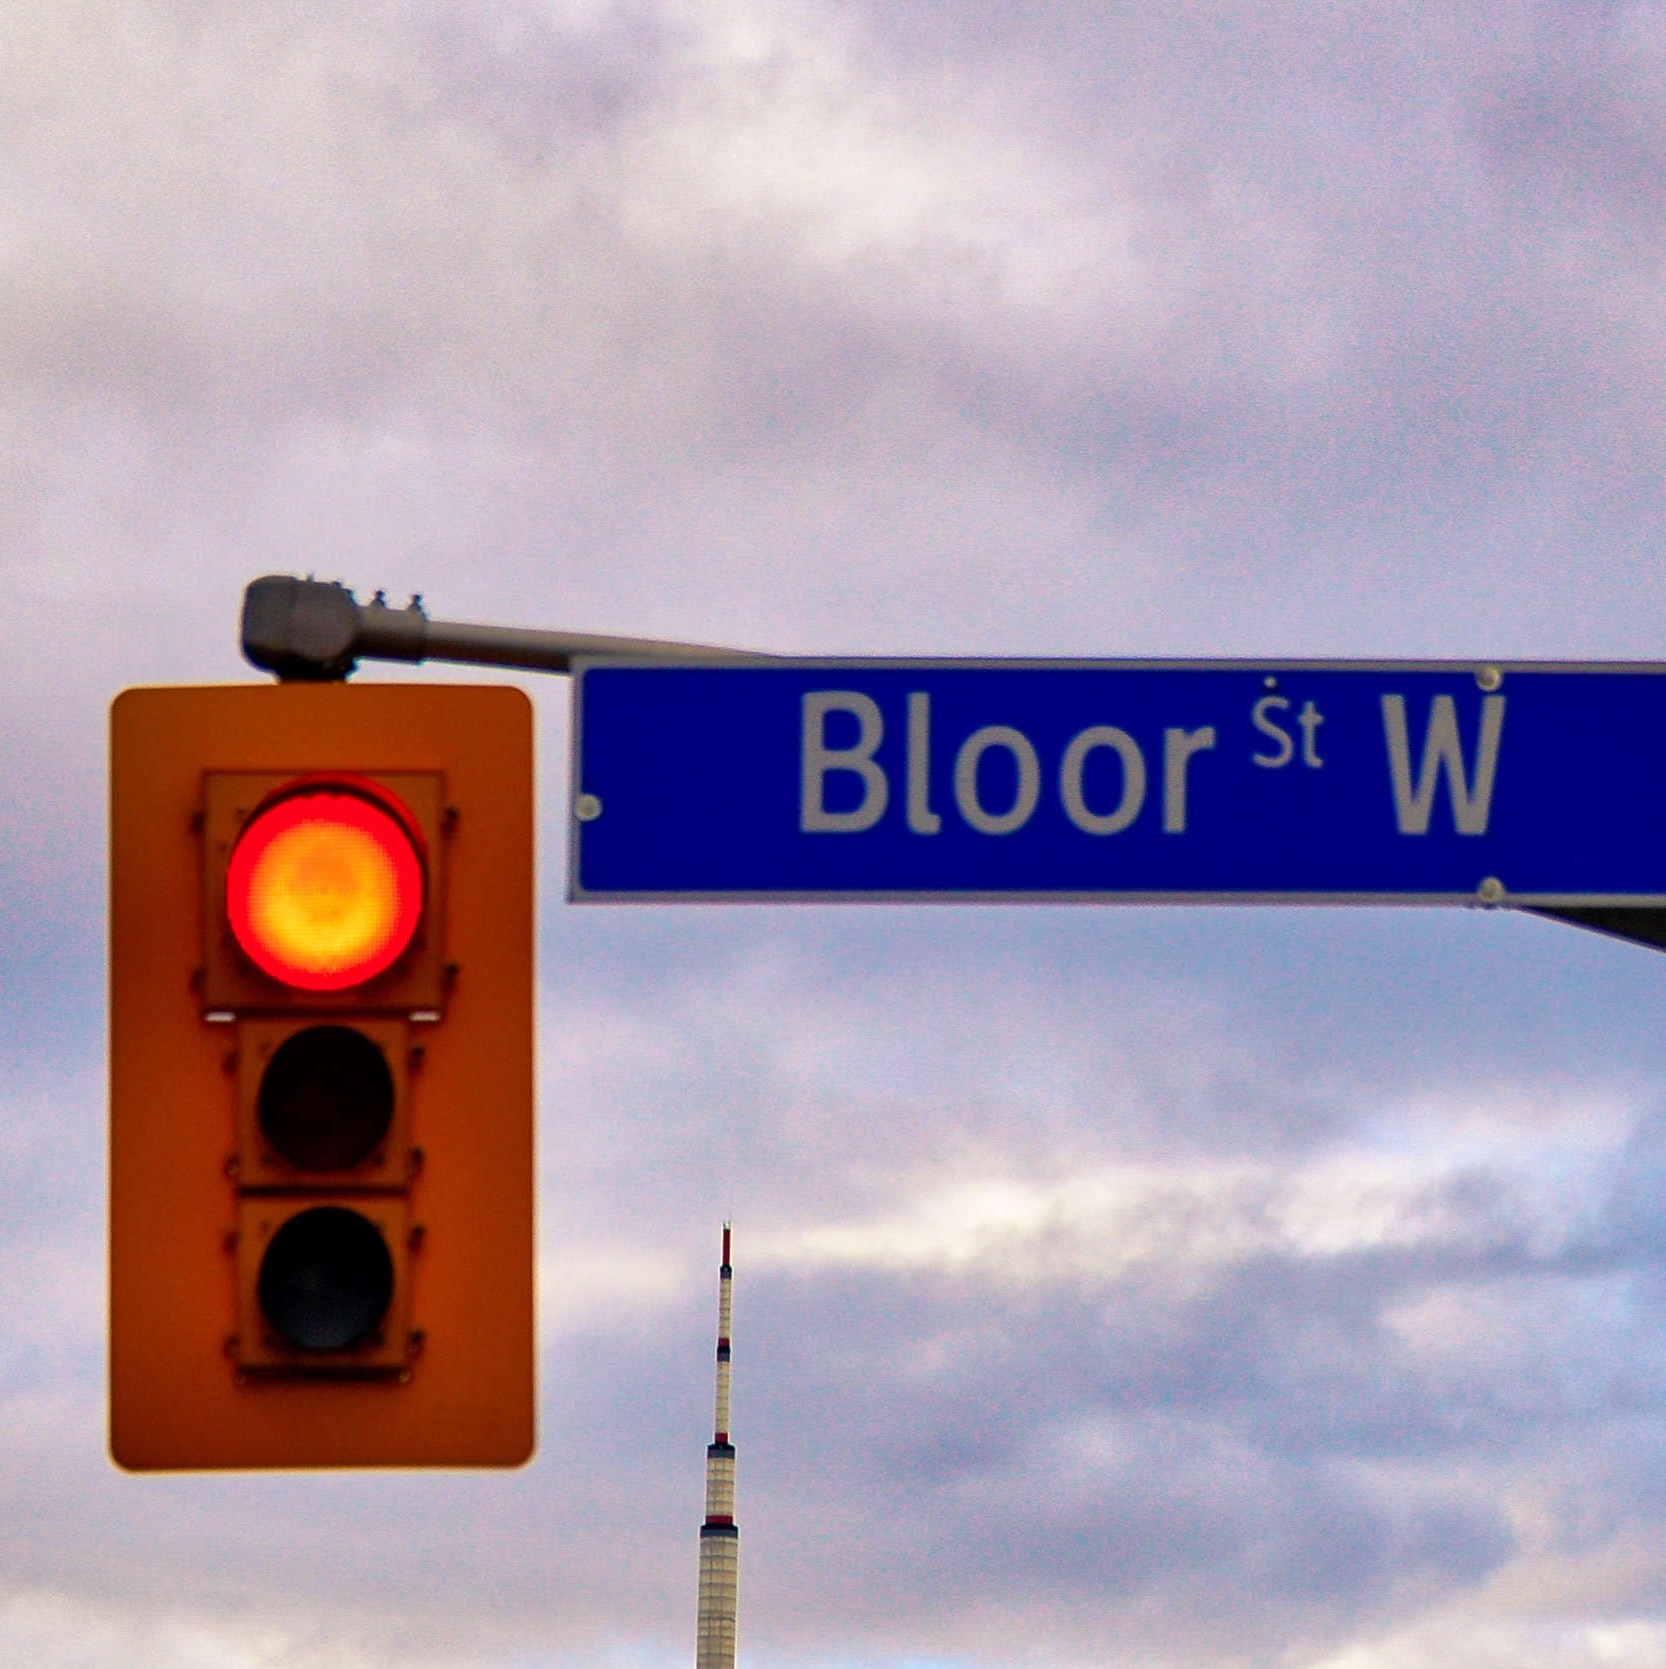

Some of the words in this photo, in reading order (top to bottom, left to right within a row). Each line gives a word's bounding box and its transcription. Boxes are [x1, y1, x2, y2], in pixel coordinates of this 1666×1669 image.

[800, 690, 1217, 836] Bloor
[1251, 695, 1325, 769] St
[1380, 694, 1507, 836] W
